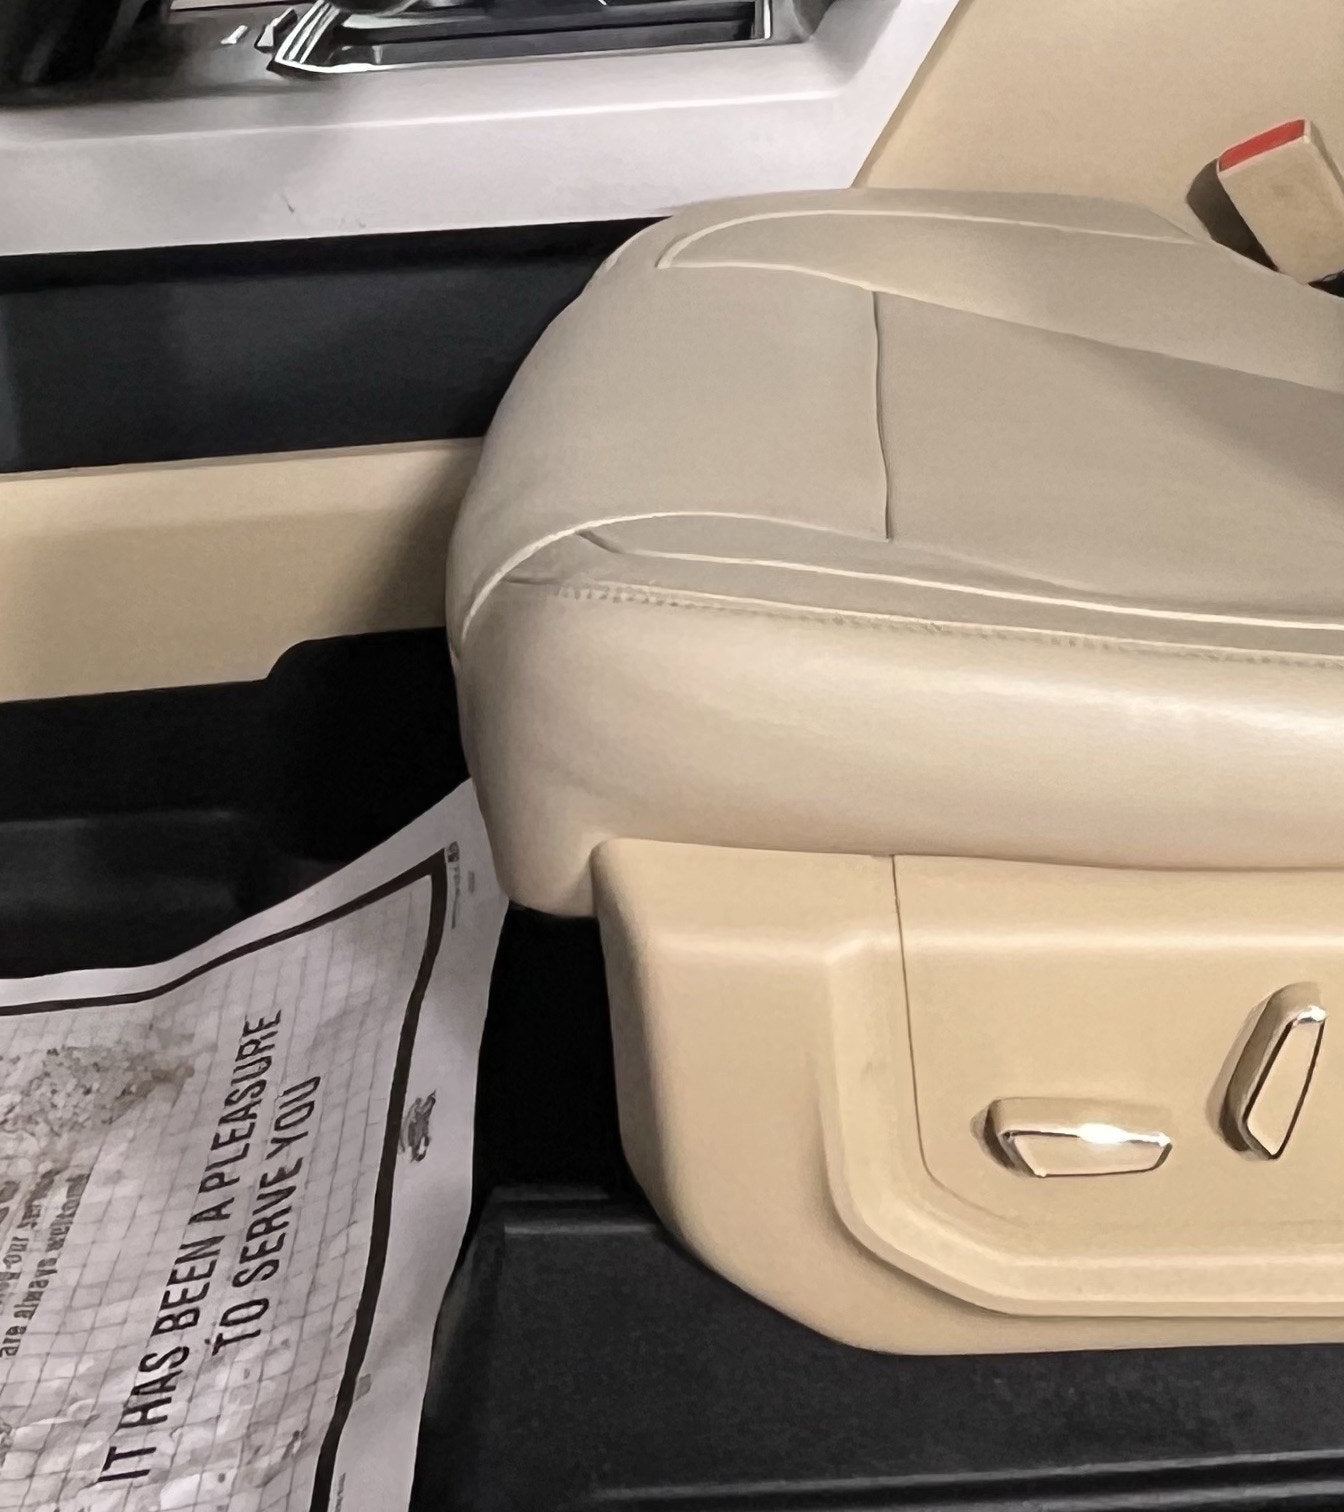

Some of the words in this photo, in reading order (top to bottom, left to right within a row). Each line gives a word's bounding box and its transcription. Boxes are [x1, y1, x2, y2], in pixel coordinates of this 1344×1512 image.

[199, 1009, 281, 1194] PLEASURE
[267, 1075, 322, 1160] YOU
[188, 1196, 235, 1226] A
[232, 1156, 303, 1288] SERVE
[152, 1234, 226, 1338] BEEN
[212, 1296, 270, 1358] TO
[119, 1345, 190, 1429] HAS
[98, 1446, 157, 1484] IT
